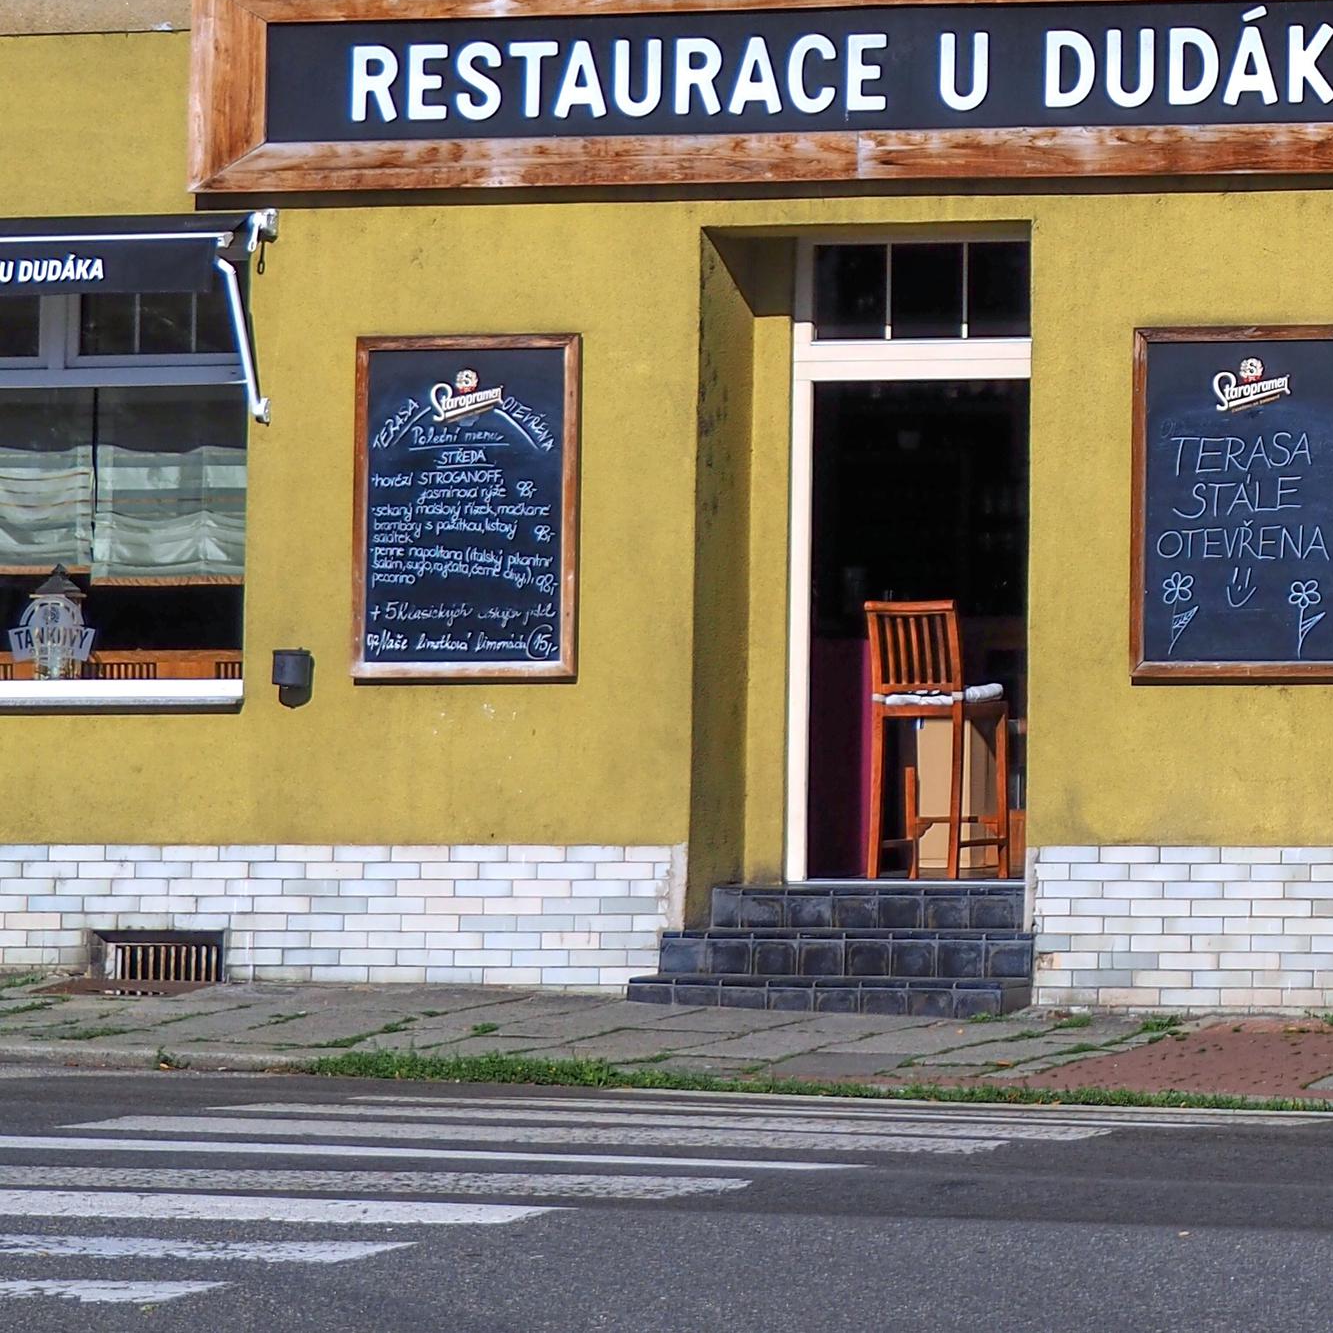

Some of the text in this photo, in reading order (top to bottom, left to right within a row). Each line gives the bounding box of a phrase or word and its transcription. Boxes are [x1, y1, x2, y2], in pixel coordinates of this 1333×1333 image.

[349, 31, 888, 123] RESTAURACE
[938, 34, 989, 112] U
[0, 254, 104, 283] U DUDÁKA
[431, 383, 503, 422] Staropramen
[1213, 372, 1291, 411] Staropramen
[373, 399, 420, 449] TERASA
[411, 426, 460, 444] Polední
[1169, 432, 1313, 476] TERASA
[1172, 474, 1302, 519] STÁLE
[1156, 520, 1330, 561] OTEVŘENA
